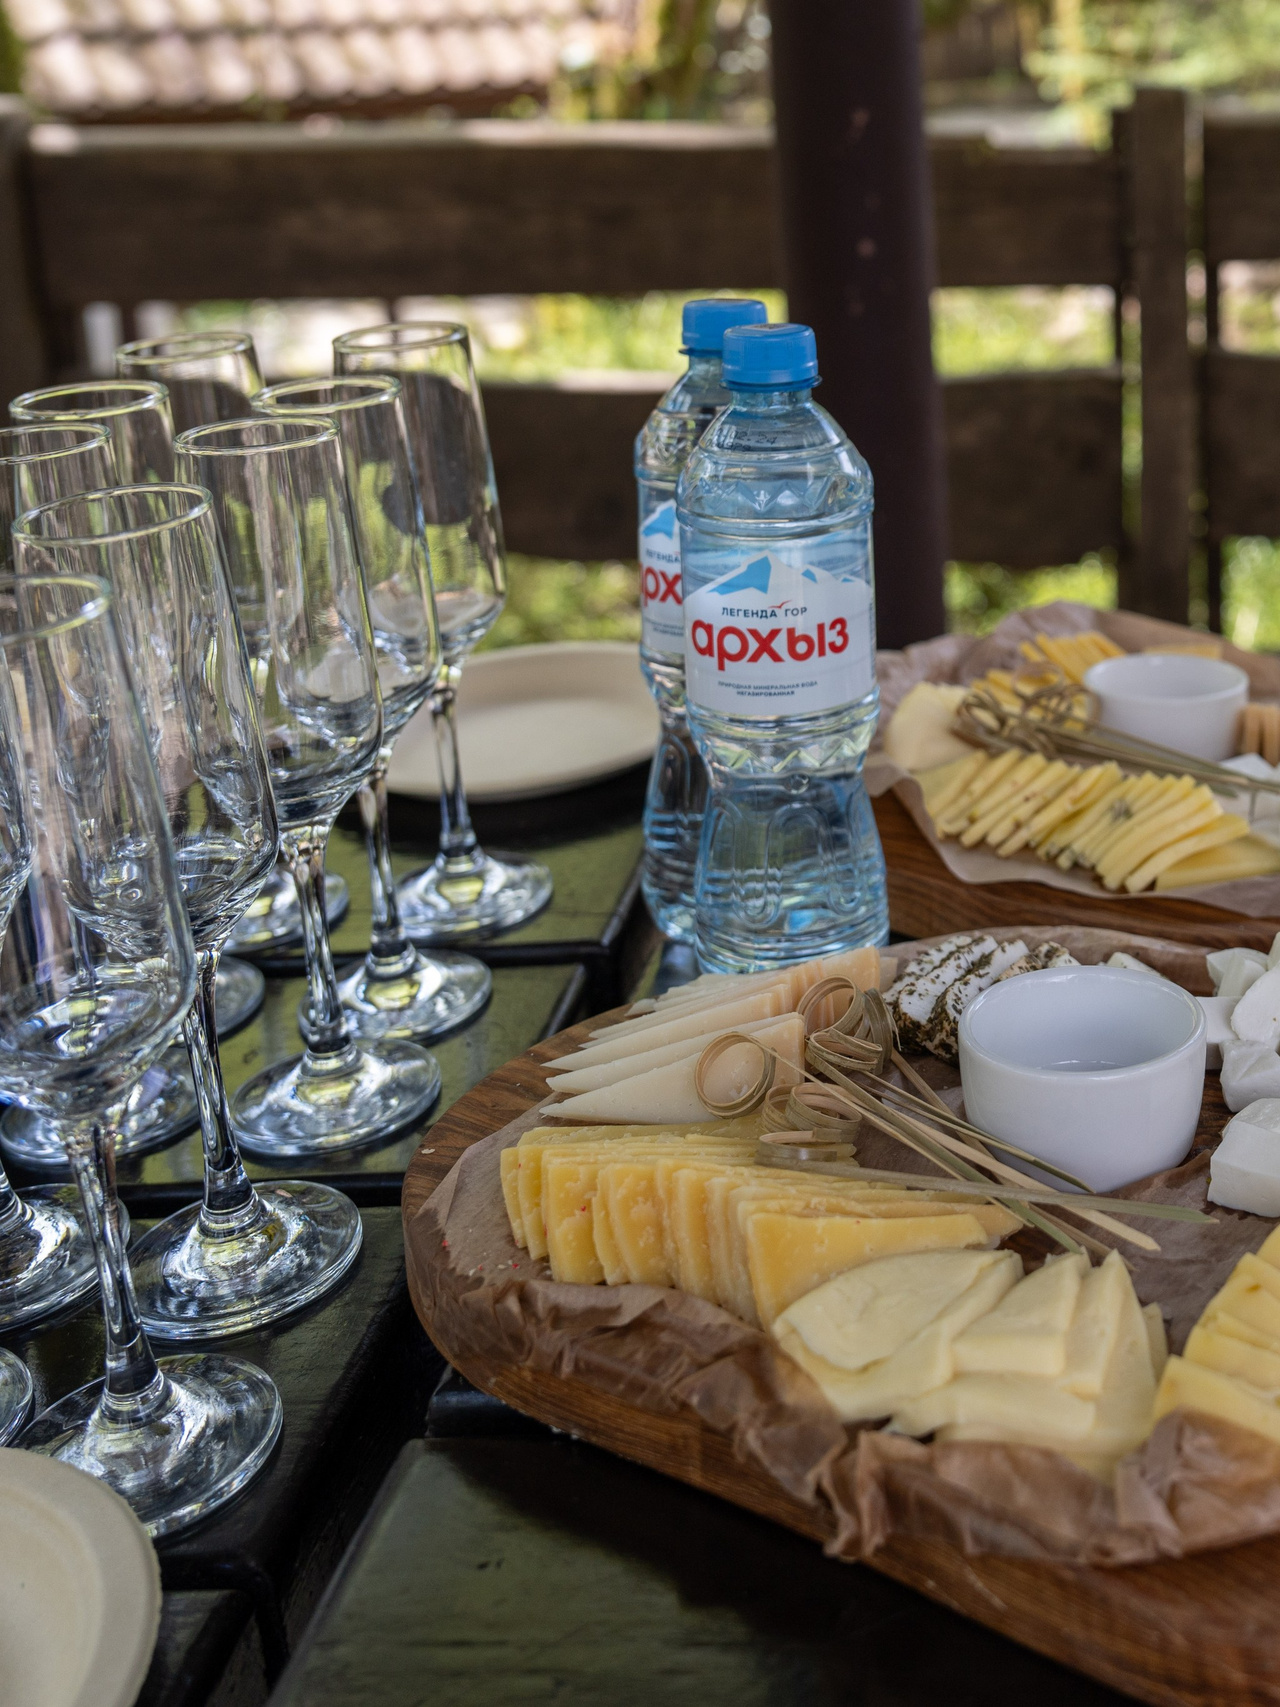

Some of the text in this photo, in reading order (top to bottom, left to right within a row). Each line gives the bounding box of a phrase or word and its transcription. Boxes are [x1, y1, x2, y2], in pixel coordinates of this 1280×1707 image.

[721, 606, 808, 619] ЛЕГЕНДА ГОР
[691, 617, 850, 672] архыз
